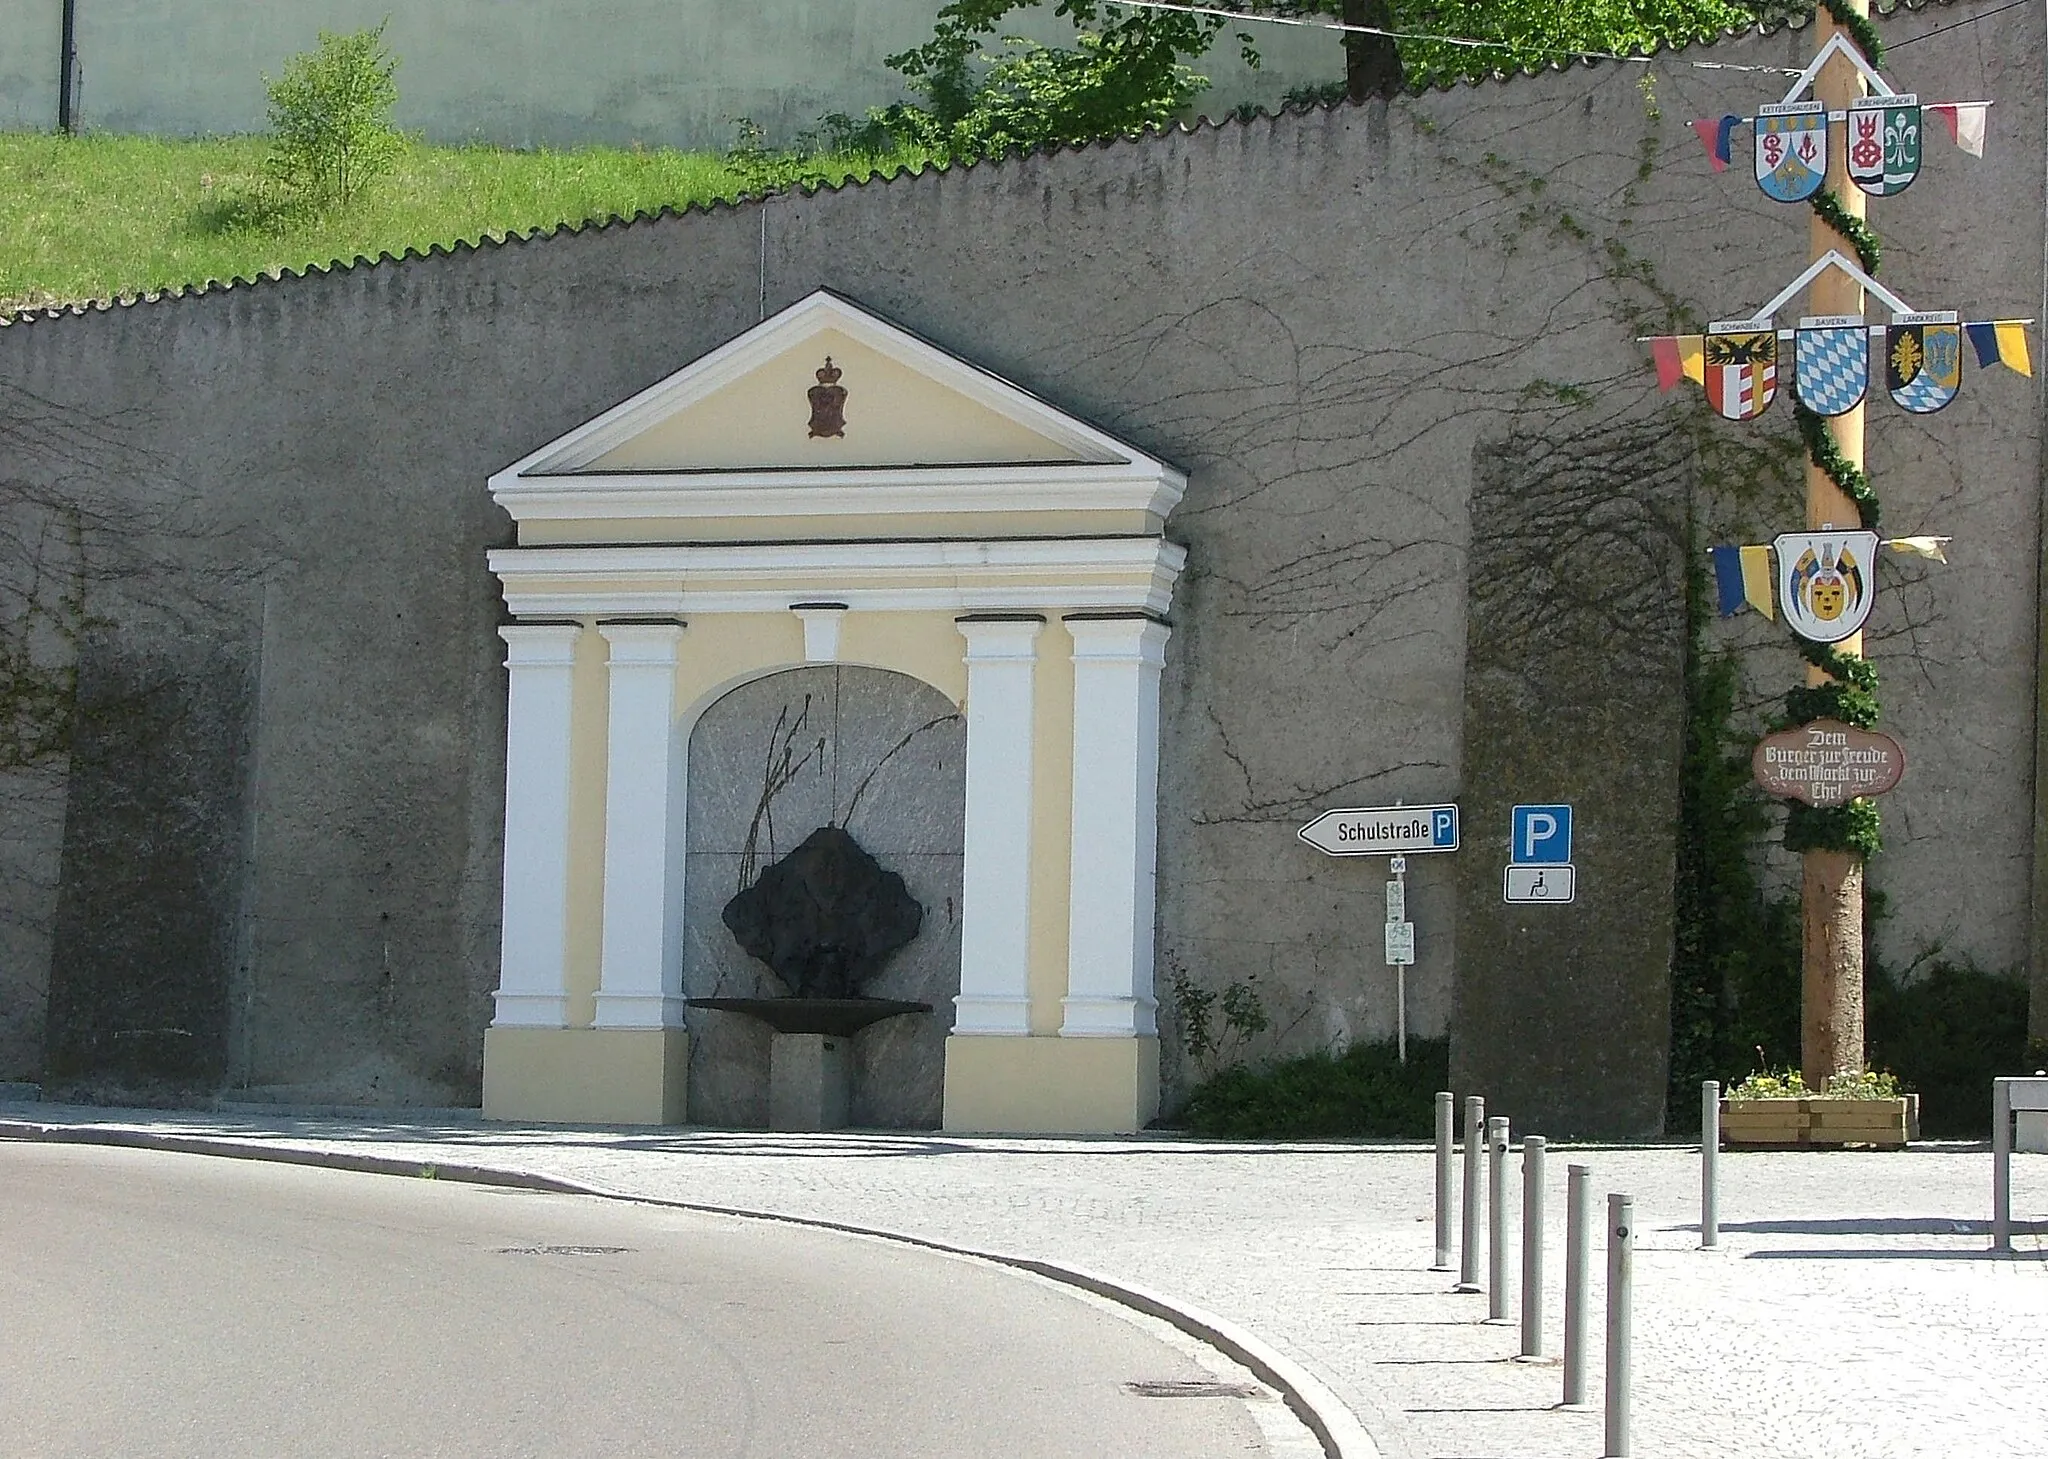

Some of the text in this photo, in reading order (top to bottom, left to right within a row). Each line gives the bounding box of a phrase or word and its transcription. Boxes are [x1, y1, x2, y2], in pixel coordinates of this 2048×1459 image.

[1806, 726, 1847, 748] Dem
[1818, 751, 1842, 766] zur
[1842, 746, 1888, 766] Freude
[1778, 762, 1877, 785] dem Markt zur
[1811, 781, 1842, 802] Ehr!
[1338, 819, 1429, 842] Schulstraße
[1525, 813, 1557, 857] P
